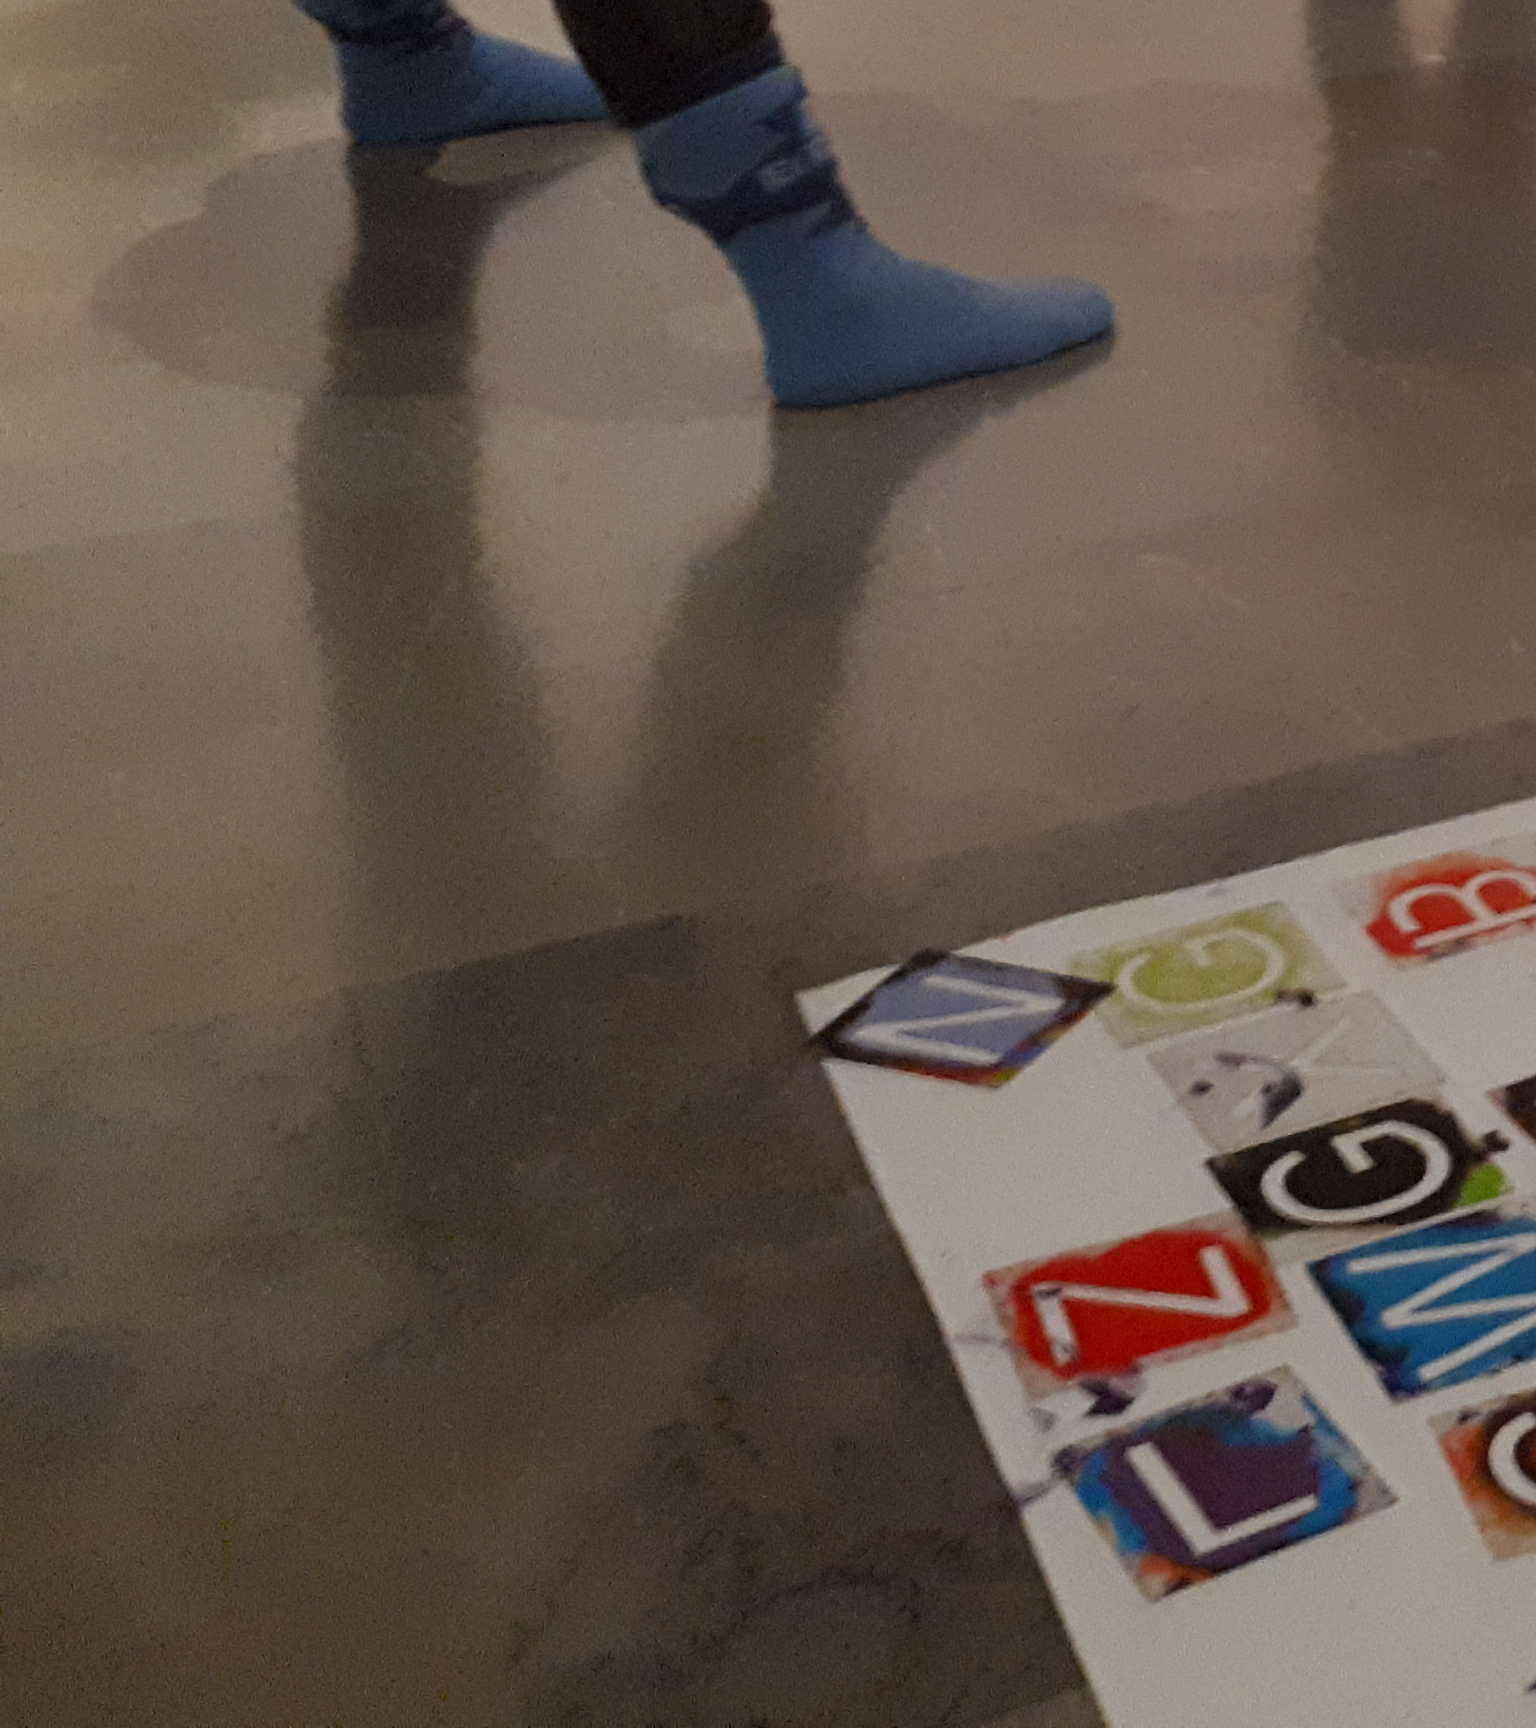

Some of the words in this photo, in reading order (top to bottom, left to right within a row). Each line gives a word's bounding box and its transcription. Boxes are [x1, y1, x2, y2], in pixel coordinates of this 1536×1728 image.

[1116, 928, 1287, 1014] G
[1260, 1119, 1454, 1227] G
[1124, 1439, 1318, 1557] L
